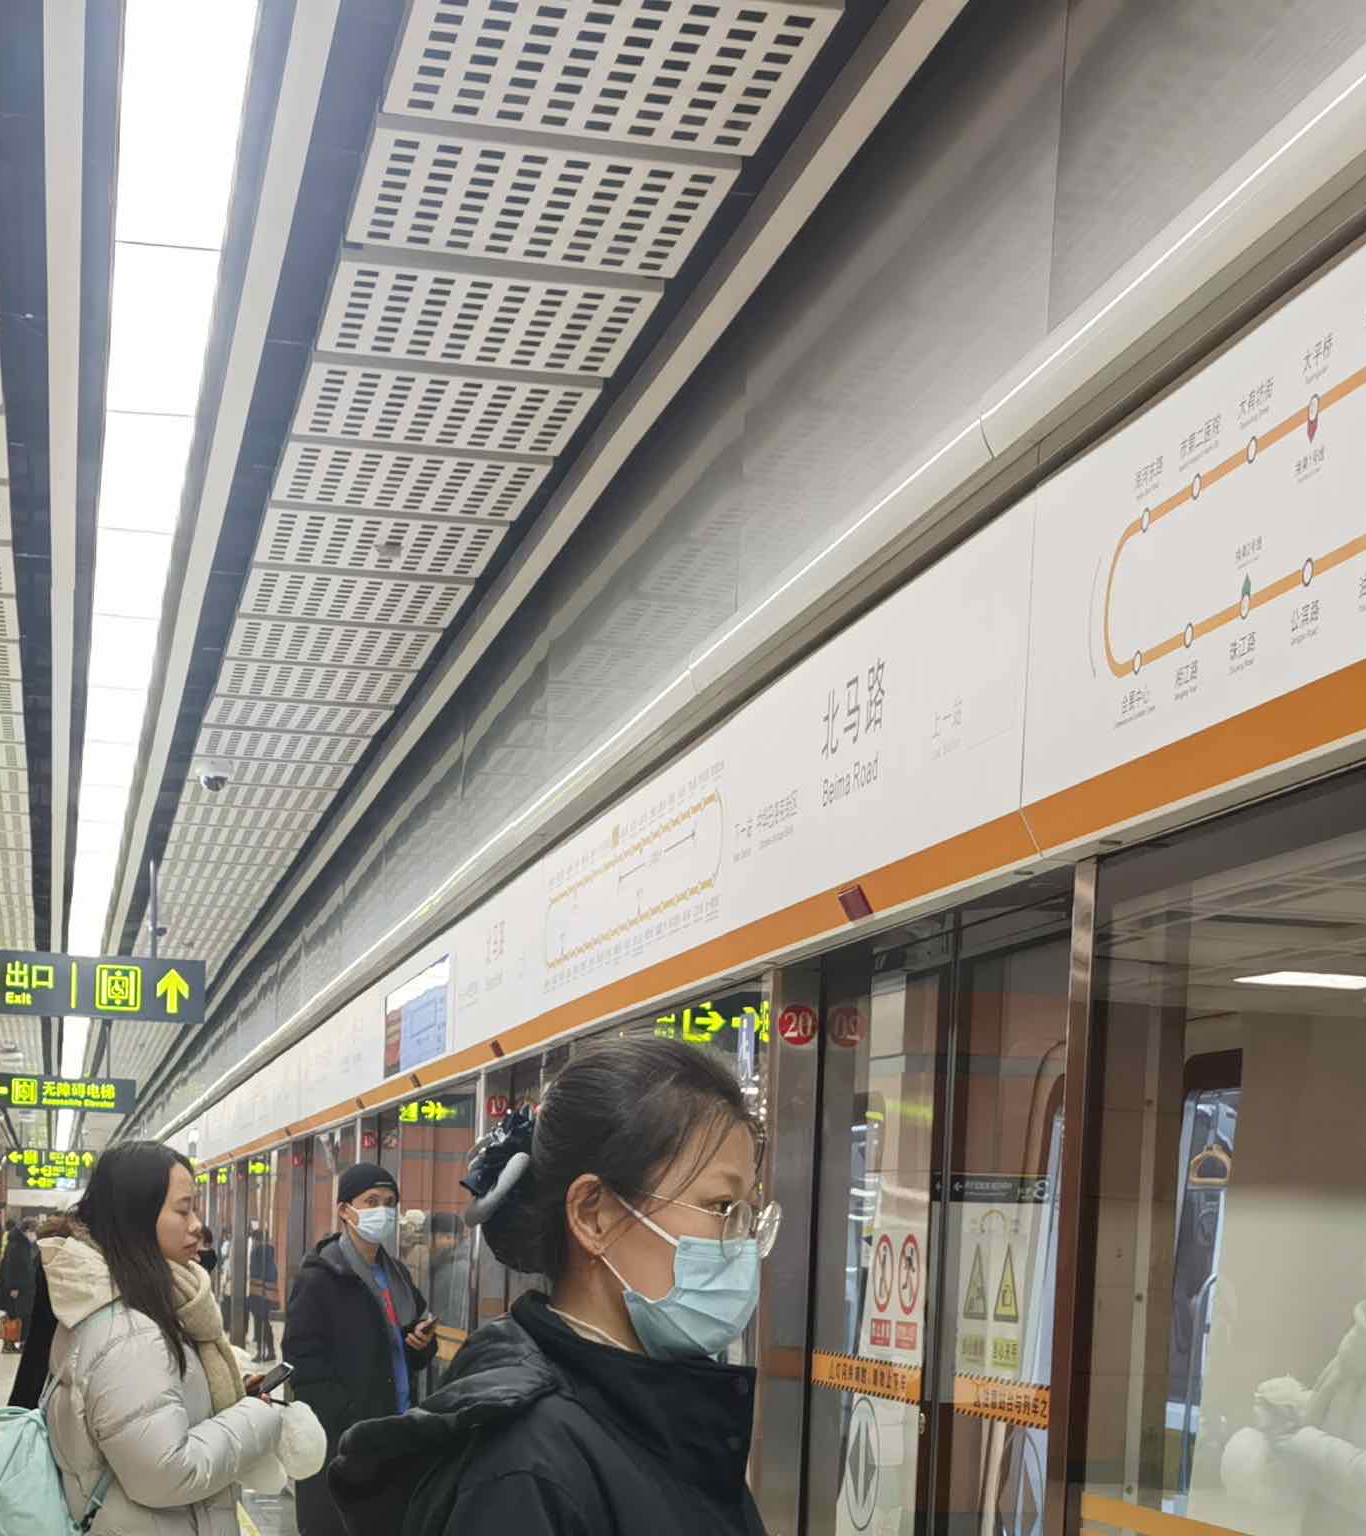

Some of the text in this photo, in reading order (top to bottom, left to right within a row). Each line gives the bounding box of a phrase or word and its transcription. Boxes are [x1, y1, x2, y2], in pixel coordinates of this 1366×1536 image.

[821, 657, 885, 760] 北马路
[822, 750, 879, 808] Beima Road
[6, 961, 54, 989] 出口
[5, 992, 32, 1006] Exit
[784, 1011, 811, 1038] 20
[43, 1081, 116, 1099] 无障碍电梯
